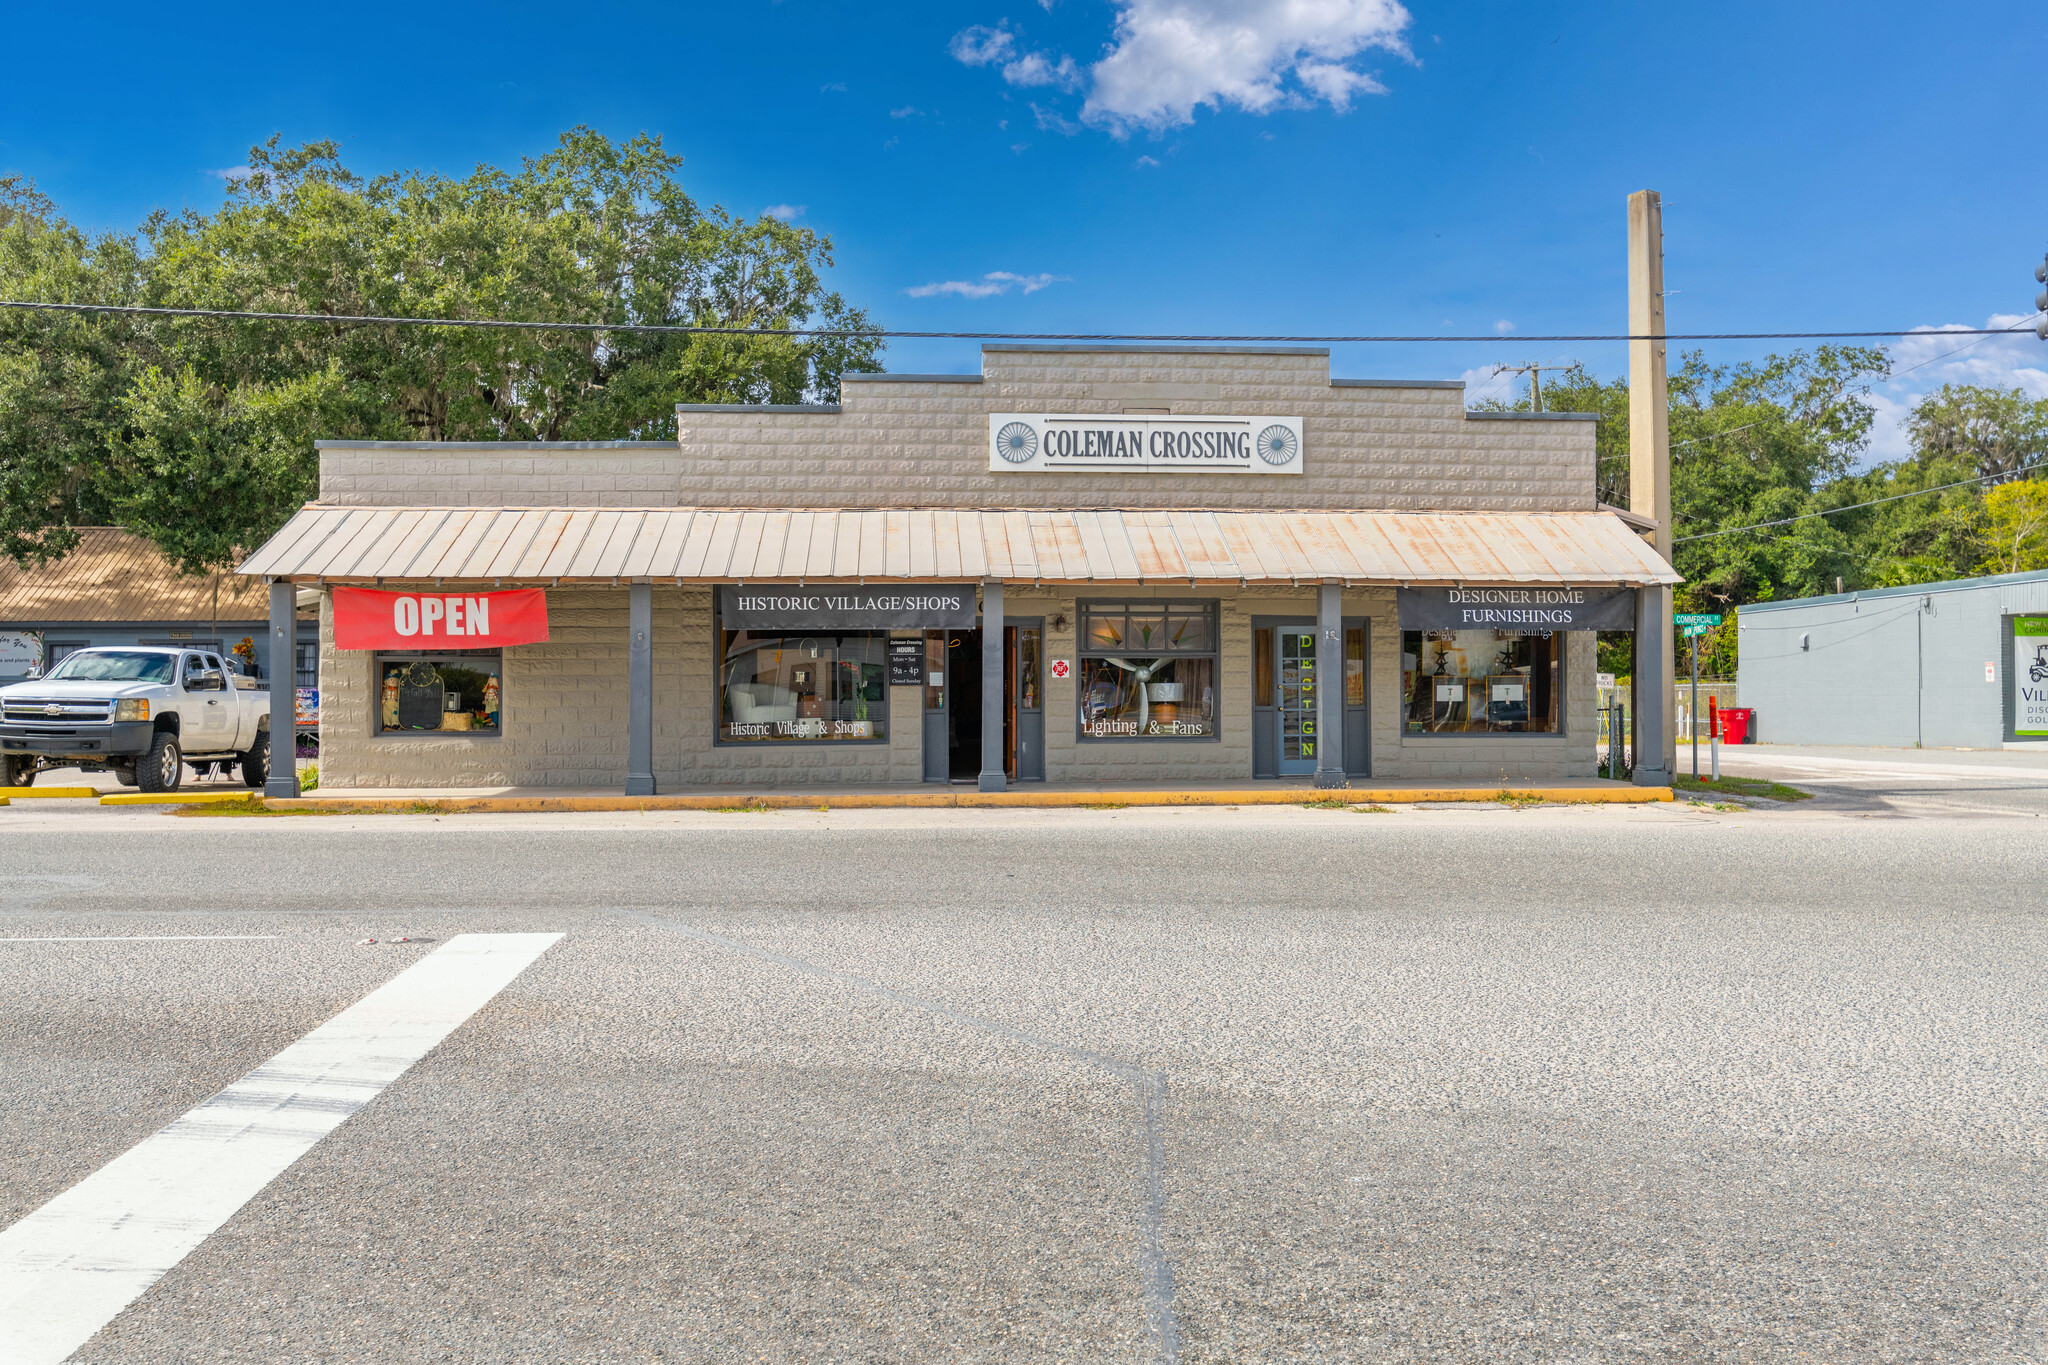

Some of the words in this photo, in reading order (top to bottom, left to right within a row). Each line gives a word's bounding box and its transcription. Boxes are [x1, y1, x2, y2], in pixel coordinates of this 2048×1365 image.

[1043, 430, 1143, 458] COLEMAN
[1149, 431, 1250, 459] CROSSING
[737, 597, 820, 611] HISTORIC
[824, 596, 960, 611] VILLAGE/SHOPS
[1448, 590, 1532, 604] DESIGNER
[1535, 590, 1585, 604] HOME
[394, 596, 490, 636] OPEN
[1462, 609, 1572, 623] FURNISHINGS
[1676, 615, 1713, 624] COMMERCIAL
[896, 646, 916, 654] HOURS
[893, 666, 903, 675] 9a
[908, 666, 919, 676] 4p
[730, 721, 770, 736] Historic
[776, 720, 811, 738] Village
[818, 721, 828, 735] &
[834, 719, 865, 737] Shops
[1083, 718, 1138, 738] Lighting
[1149, 719, 1160, 735] &
[1171, 720, 1203, 735] Fans
